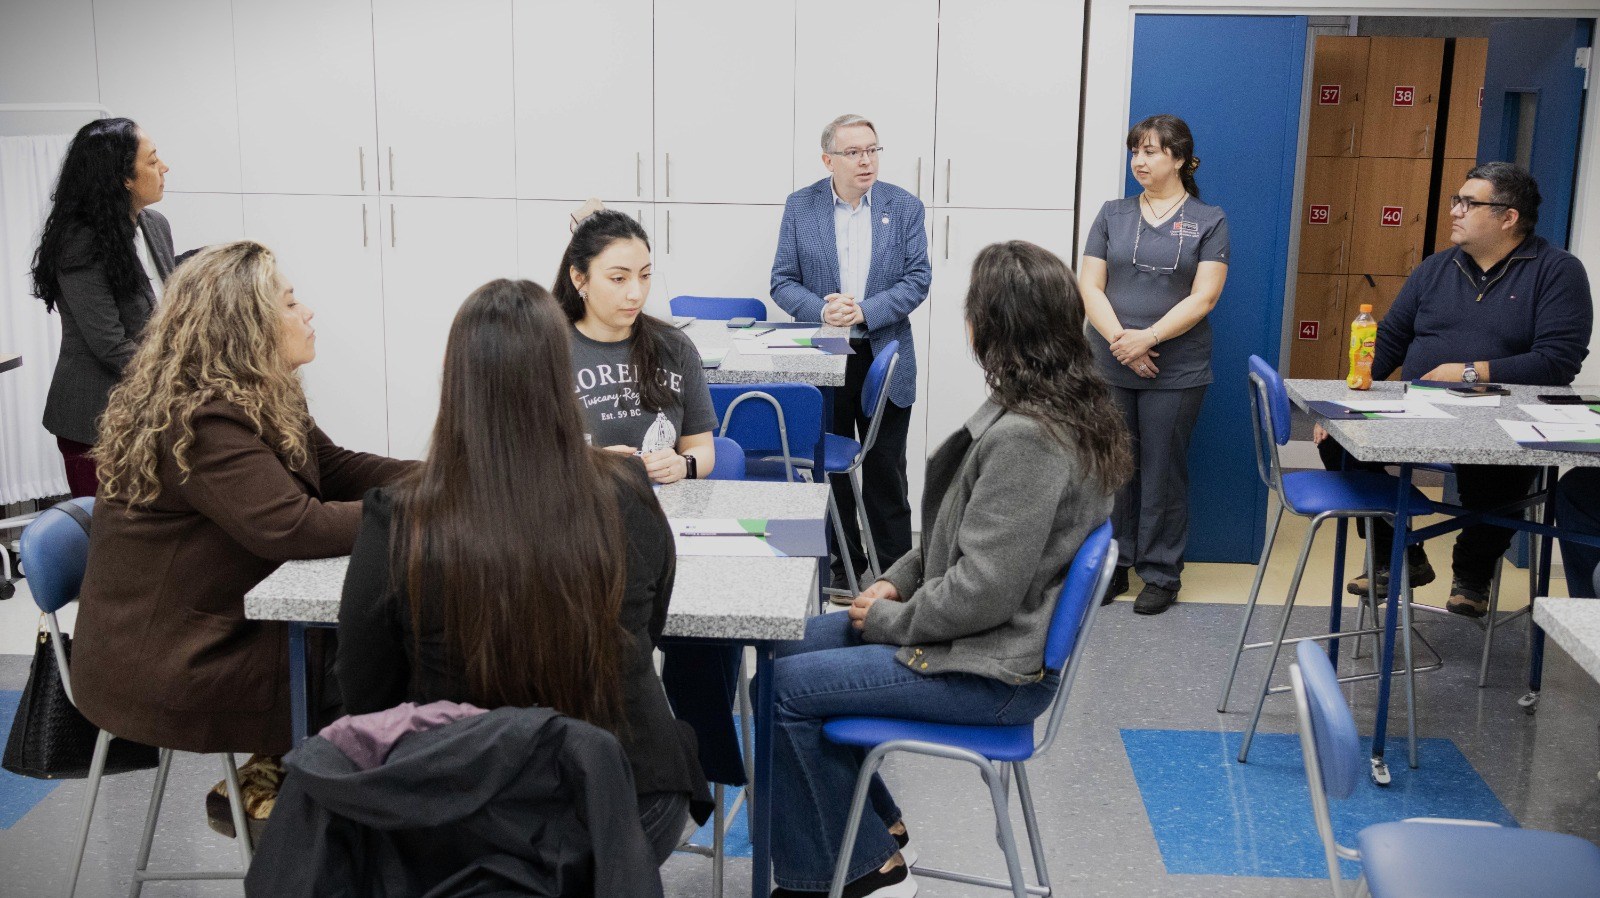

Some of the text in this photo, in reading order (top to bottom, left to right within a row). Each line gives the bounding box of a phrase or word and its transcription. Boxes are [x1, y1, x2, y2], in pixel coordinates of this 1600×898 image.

[1322, 90, 1338, 100] 37
[1396, 91, 1412, 101] 38
[1312, 209, 1328, 220] 39
[1384, 211, 1401, 221] 40
[1302, 326, 1315, 335] 41
[578, 394, 620, 408] Tuscany
[601, 409, 641, 421] Est. 59 BC
